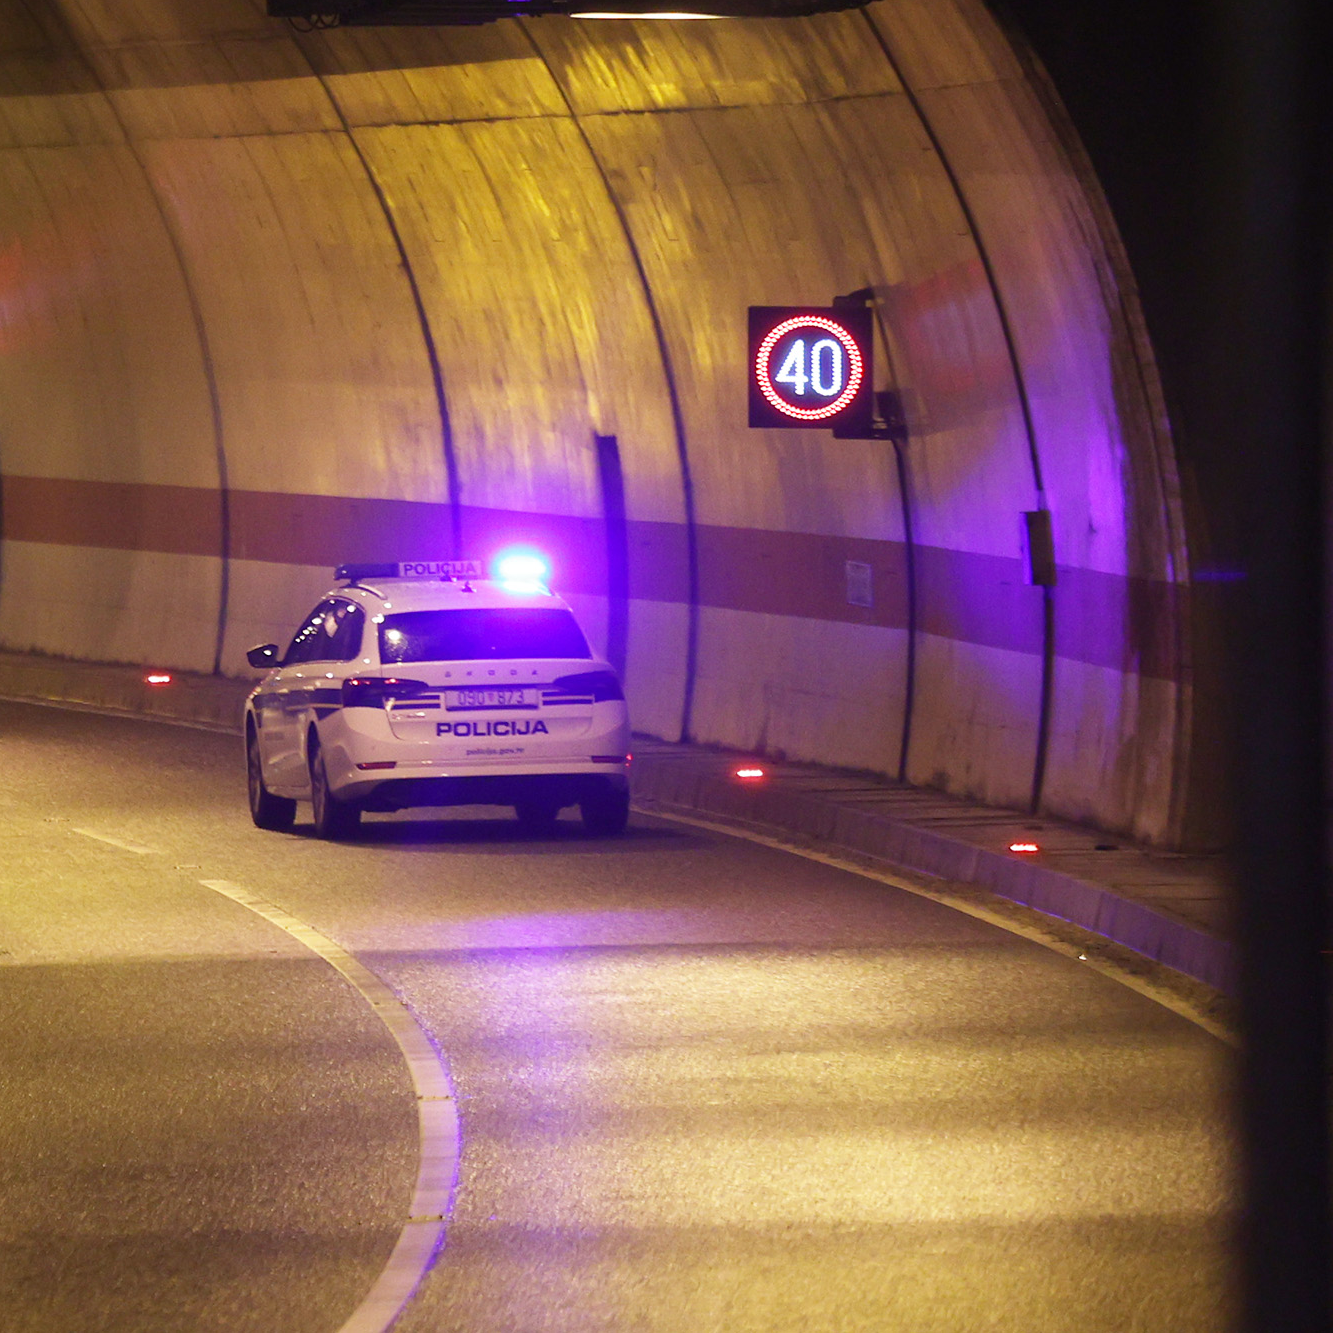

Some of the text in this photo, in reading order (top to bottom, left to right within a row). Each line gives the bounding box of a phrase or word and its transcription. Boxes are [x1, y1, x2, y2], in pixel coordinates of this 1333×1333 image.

[775, 339, 842, 396] 40
[403, 562, 476, 576] POLICIJA
[436, 720, 549, 737] POLICIJA
